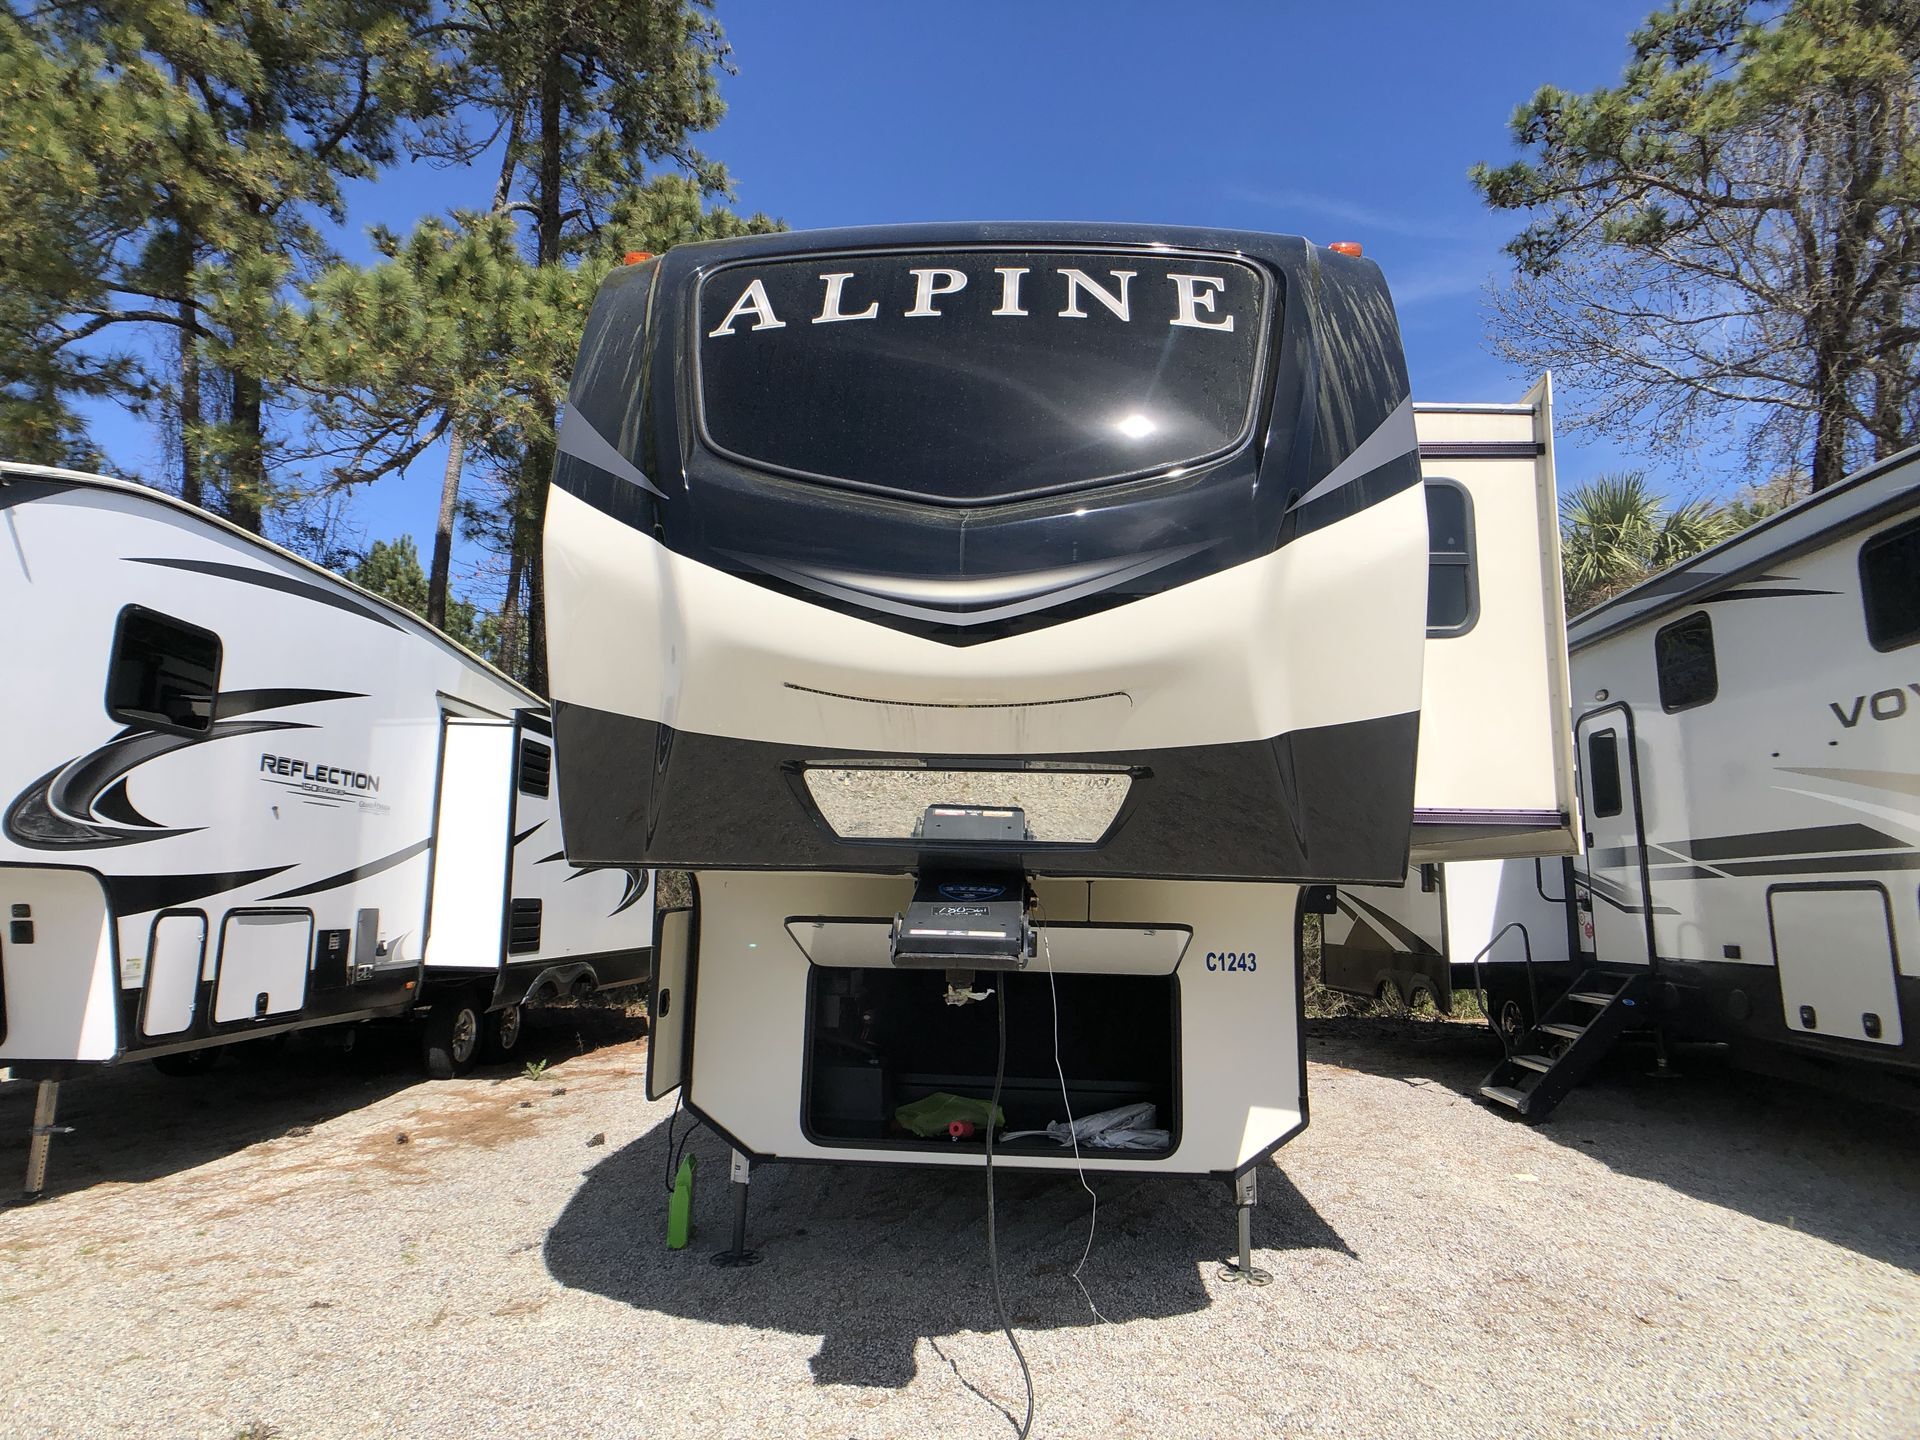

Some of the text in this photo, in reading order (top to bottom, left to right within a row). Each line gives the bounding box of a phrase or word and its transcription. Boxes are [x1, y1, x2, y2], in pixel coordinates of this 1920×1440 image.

[709, 267, 1234, 338] ALPINE
[260, 753, 380, 792] REFLECTION
[1206, 952, 1257, 972] C1243
